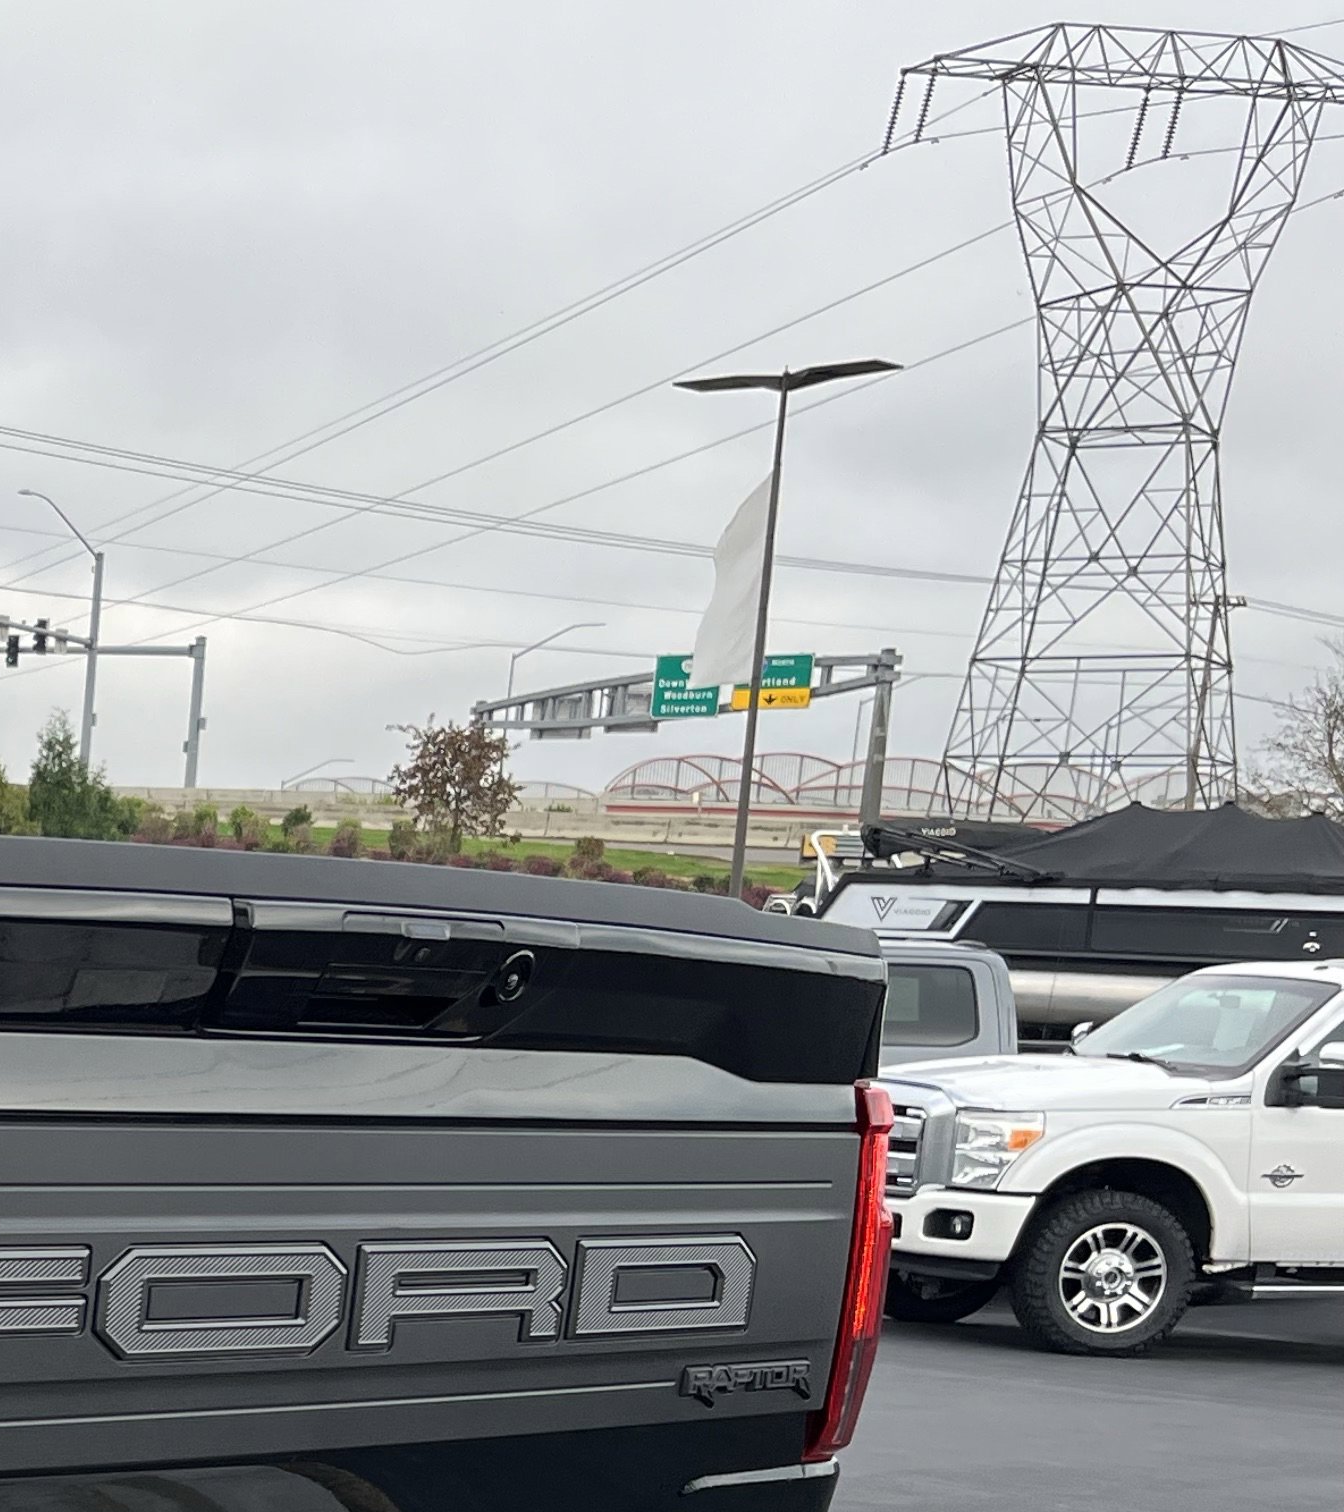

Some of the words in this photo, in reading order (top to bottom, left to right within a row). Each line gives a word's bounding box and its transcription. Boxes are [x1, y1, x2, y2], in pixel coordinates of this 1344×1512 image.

[762, 677, 796, 686] rtland
[663, 690, 713, 700] Woodburn
[780, 696, 806, 704] ONLY
[660, 704, 708, 714] Silverton
[680, 1358, 811, 1407] RAPTOR
